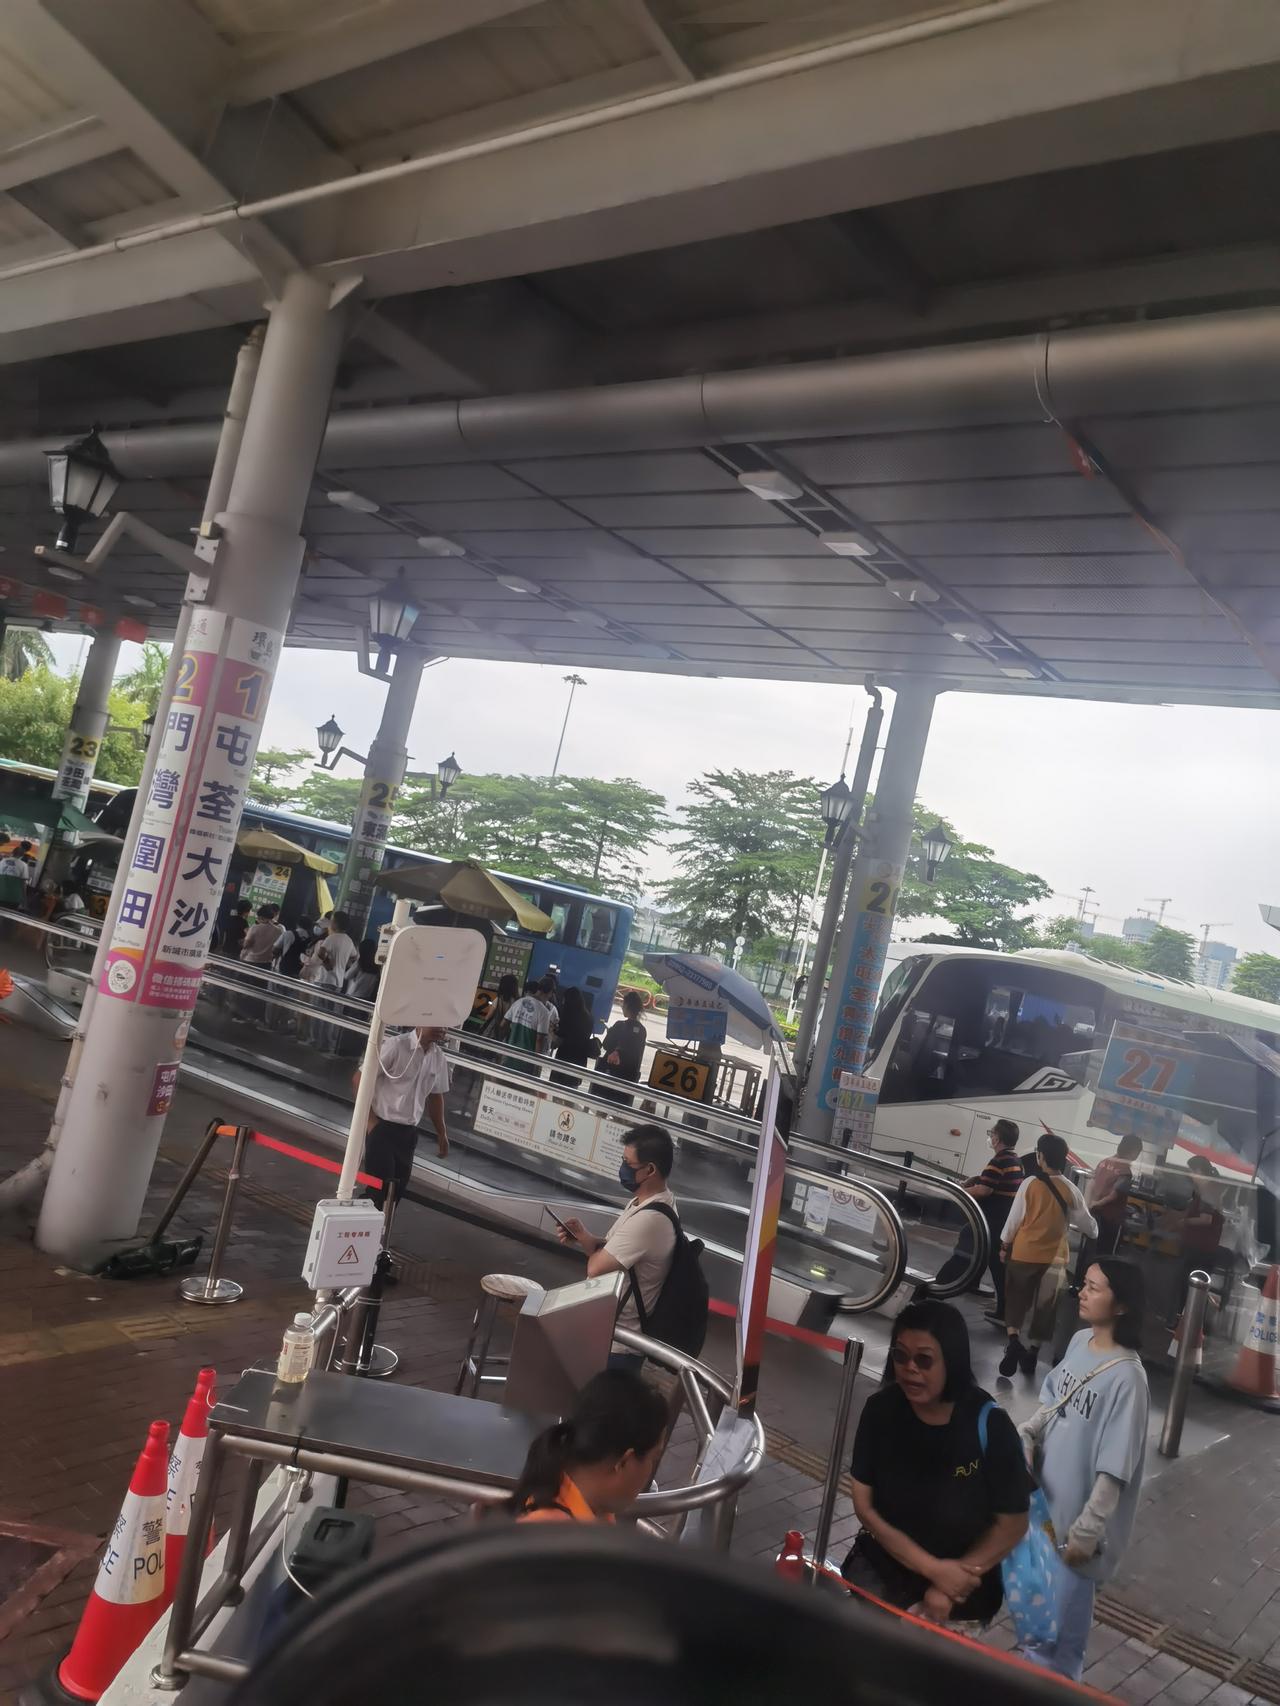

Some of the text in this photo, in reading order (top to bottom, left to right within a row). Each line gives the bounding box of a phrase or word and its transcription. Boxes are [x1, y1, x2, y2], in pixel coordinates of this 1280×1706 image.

[172, 654, 198, 701] 2
[235, 671, 264, 720] 1
[70, 738, 98, 758] 23
[659, 1061, 698, 1092] 26
[1116, 1048, 1176, 1097] 27
[954, 1459, 979, 1478] RUN
[142, 1518, 164, 1545] 警
